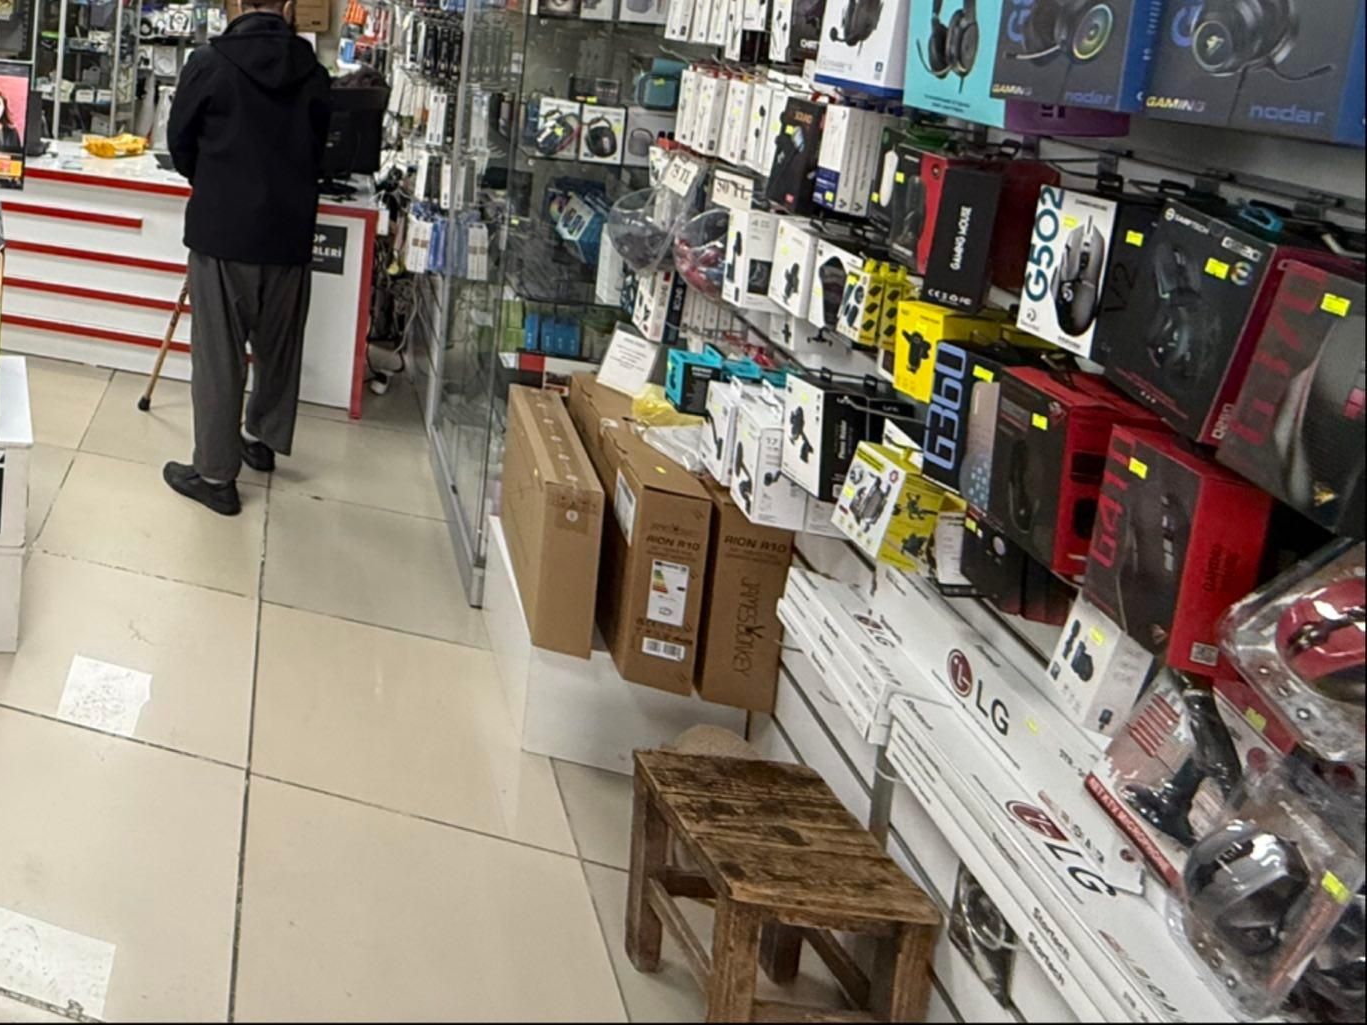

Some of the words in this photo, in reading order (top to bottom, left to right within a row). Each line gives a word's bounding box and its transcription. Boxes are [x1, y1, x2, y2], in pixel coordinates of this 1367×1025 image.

[992, 82, 1033, 96] GAMING
[1145, 95, 1206, 113] GAMING
[1248, 104, 1325, 125] nodar
[949, 236, 967, 272] GAMING
[958, 205, 973, 236] MOUSE
[1024, 185, 1066, 303] G502
[923, 340, 968, 471] G360
[869, 629, 895, 648] LG
[975, 679, 1010, 736] LG
[1043, 841, 1117, 898] LG
